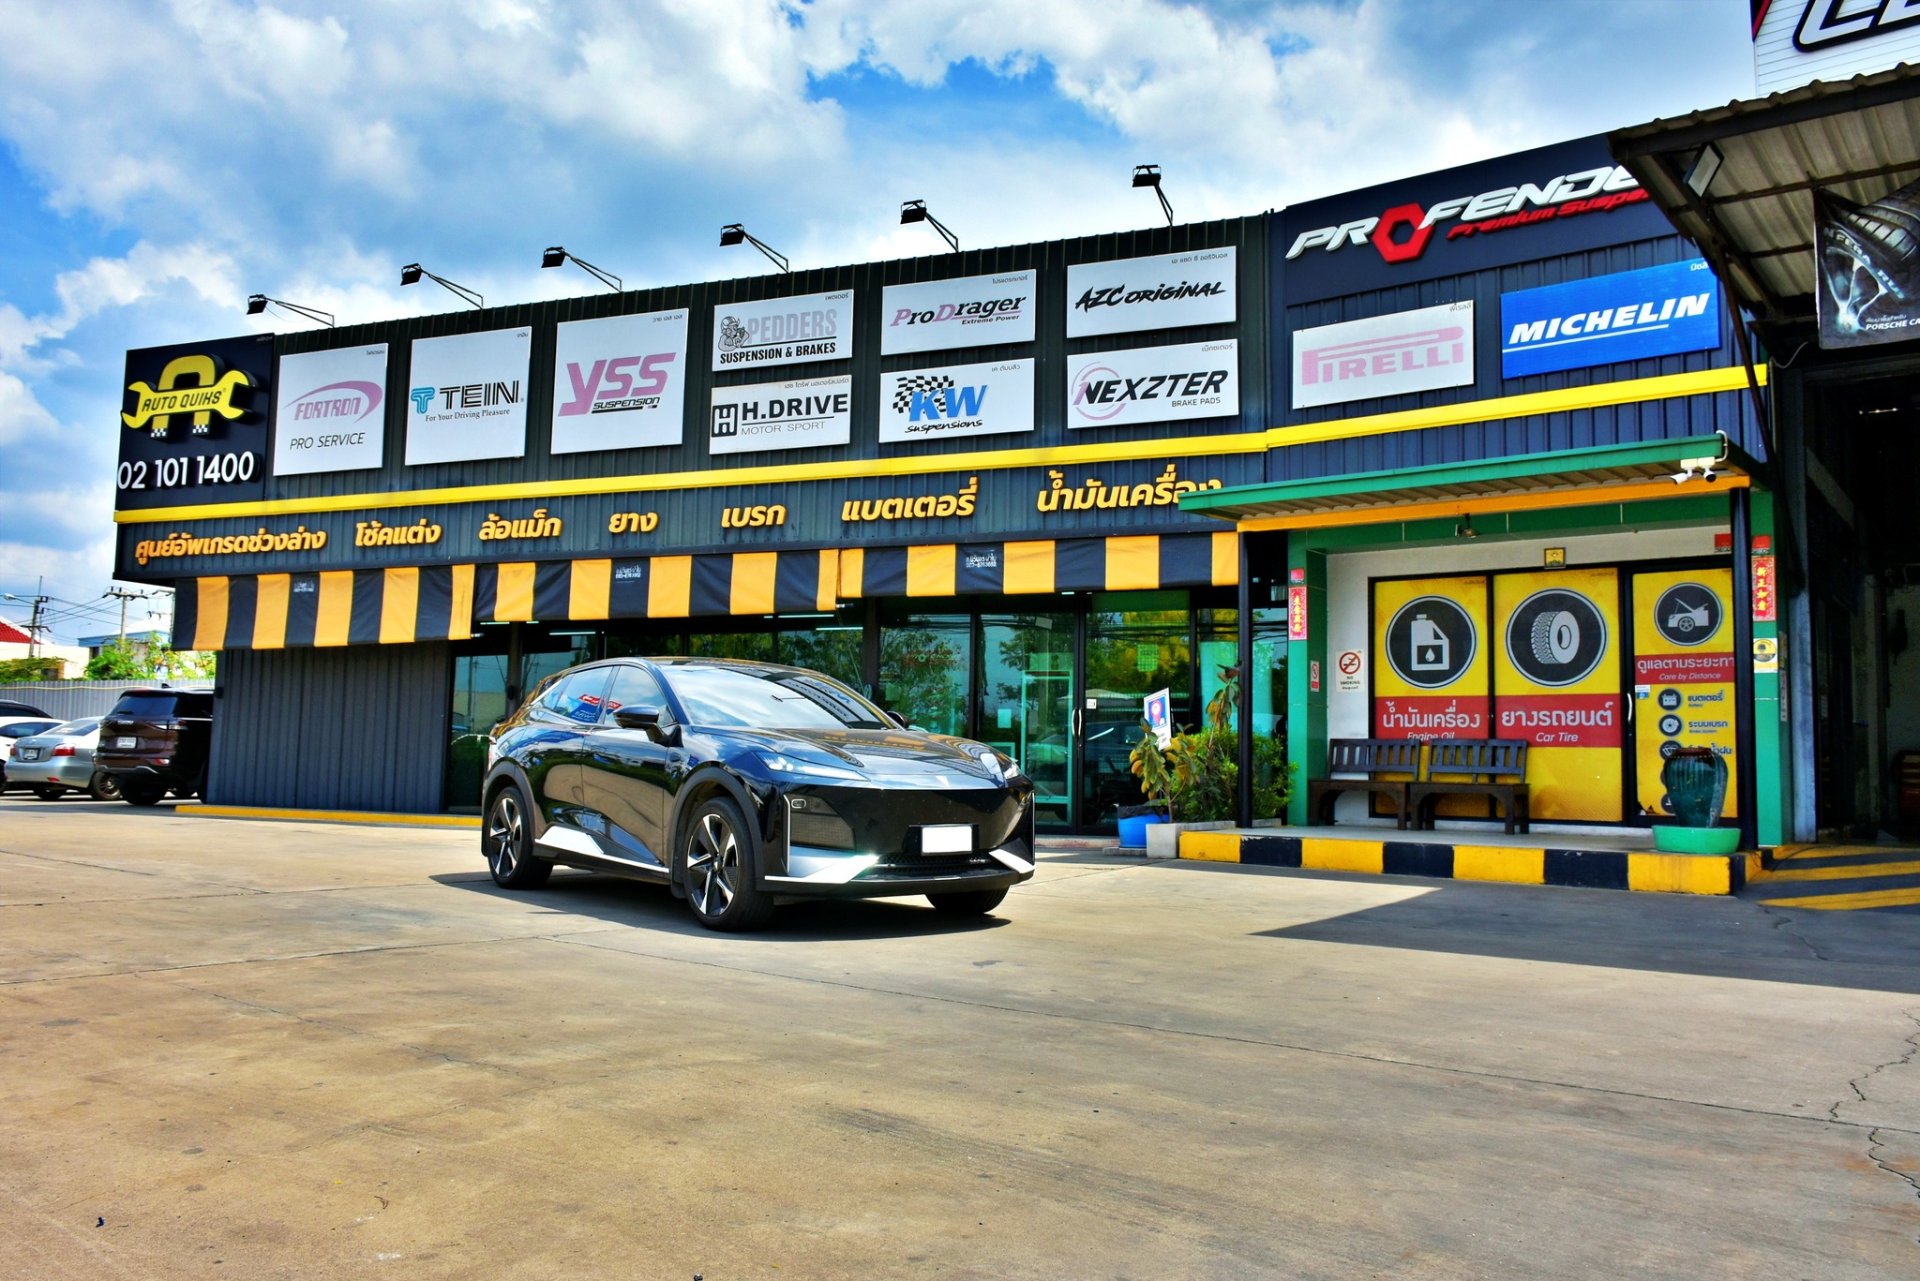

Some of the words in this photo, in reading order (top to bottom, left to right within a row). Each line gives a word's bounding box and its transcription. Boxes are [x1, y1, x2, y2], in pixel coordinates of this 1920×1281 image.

[1284, 164, 1641, 265] PROFENDE
[890, 294, 1027, 327] ProDrager
[1074, 283, 1125, 313] AZC
[747, 308, 838, 345] PEDDERS
[961, 316, 995, 326] Extreme
[995, 314, 1020, 323] Power
[1508, 293, 1711, 345] MICHELIN
[1865, 319, 1909, 331] PORSCHE
[720, 347, 783, 365] SUSPENSION
[785, 346, 793, 358] &
[795, 341, 836, 357] BRAKES
[1301, 325, 1465, 386] PIRELLI
[439, 379, 520, 410] TEIN
[558, 352, 677, 417] YSS
[1072, 369, 1229, 407] NEXZTER
[141, 395, 178, 413] AUTO
[294, 396, 362, 421] FORTRON
[425, 414, 437, 422] For
[437, 411, 453, 421] Your
[454, 410, 481, 420] Driving
[481, 408, 511, 418] Pleasure
[742, 393, 849, 421] H.DRIVE
[908, 385, 988, 422] KW
[1171, 398, 1198, 408] BRAKE
[1199, 396, 1222, 406] PADS
[289, 436, 315, 450] PRO
[316, 432, 366, 448] SERVICE
[741, 424, 782, 436] MOTOR
[787, 421, 826, 433] SPORT
[904, 419, 984, 435] suspensions
[117, 460, 147, 490] 02
[154, 456, 189, 488] 101
[196, 450, 255, 485] 1400
[135, 525, 327, 566] ศูนย์อัพเกรดช่วงล่าง
[354, 518, 443, 547] โช้คแต่ง
[478, 507, 564, 541] ล้อแม็ก
[608, 510, 659, 534] ยาง
[720, 503, 787, 528] เบรก
[840, 476, 979, 522] แบตเตอรี่
[1658, 672, 1677, 681] Care
[1678, 672, 1687, 681] by
[1689, 672, 1721, 680] Distance
[1382, 699, 1481, 728] น้ำมันเครื่อง
[1501, 701, 1614, 727] ยางรถยนต์
[1535, 732, 1555, 742] Car
[1558, 731, 1579, 742] Tire
